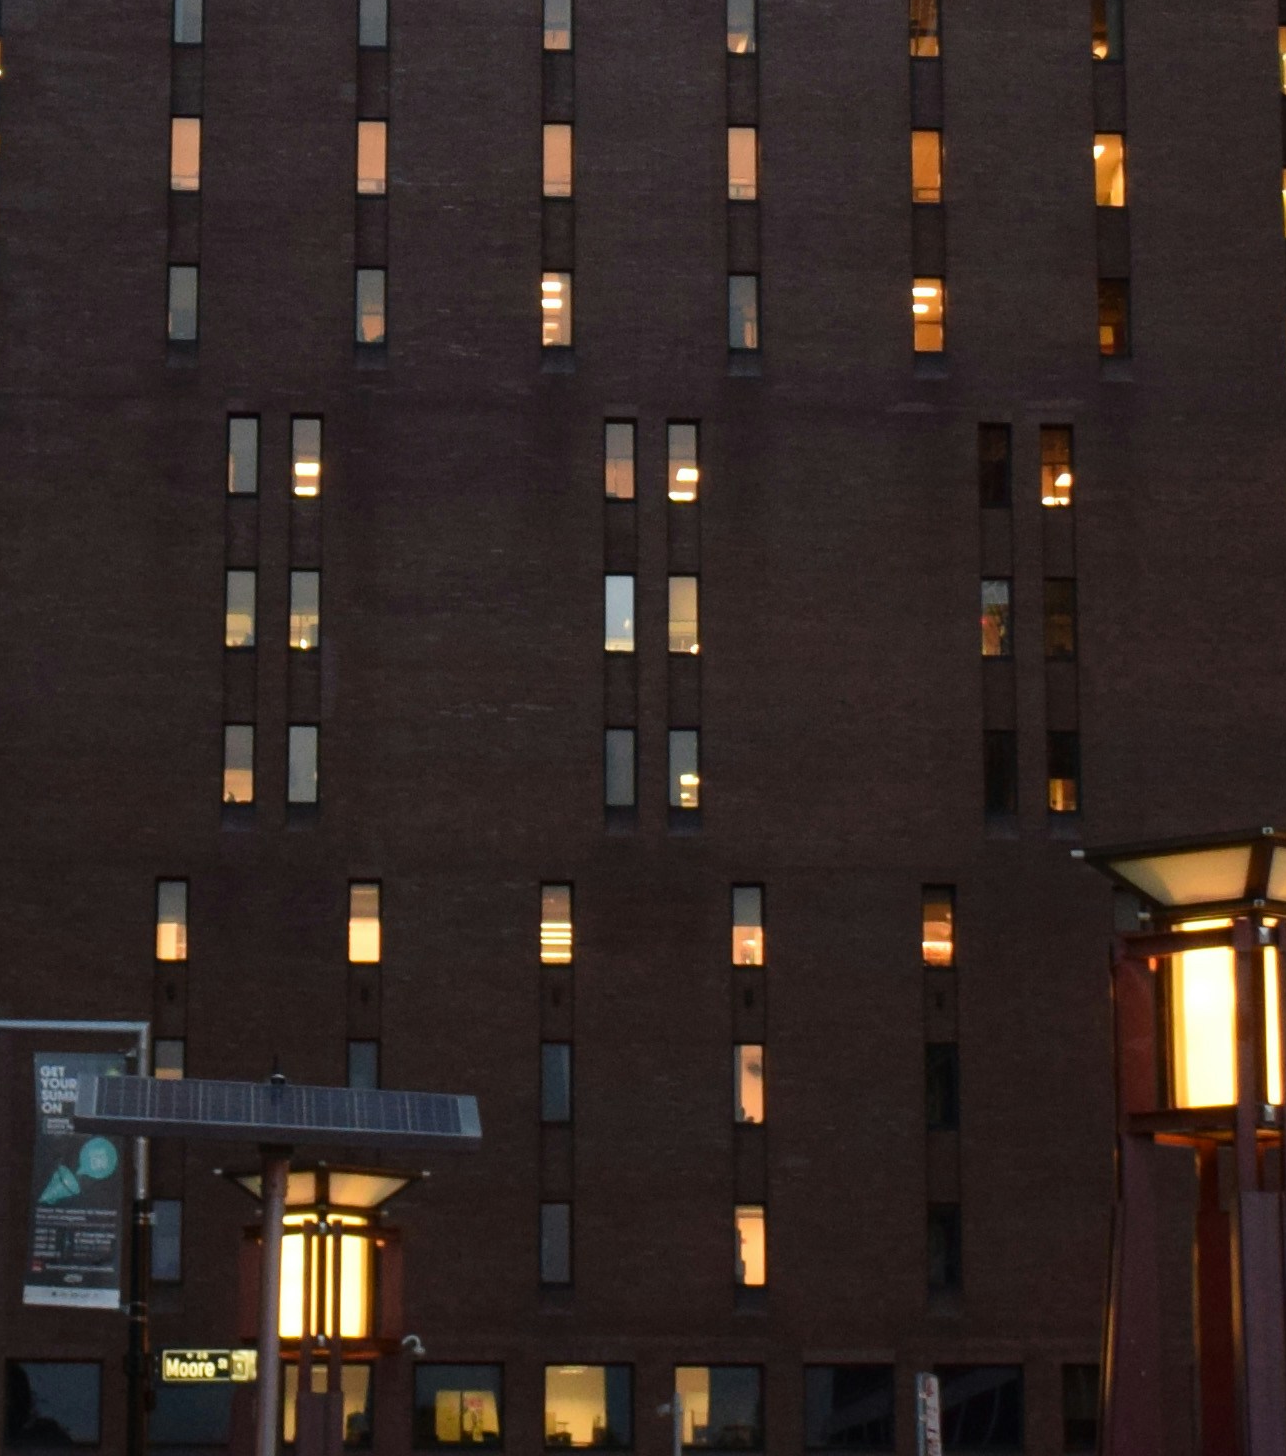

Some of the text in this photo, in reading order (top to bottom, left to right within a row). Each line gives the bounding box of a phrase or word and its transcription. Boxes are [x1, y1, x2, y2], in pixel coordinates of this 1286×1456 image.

[40, 1066, 65, 1077] GET
[41, 1078, 76, 1089] YOUR
[41, 1102, 62, 1114] ON
[165, 1357, 216, 1378] Moore
